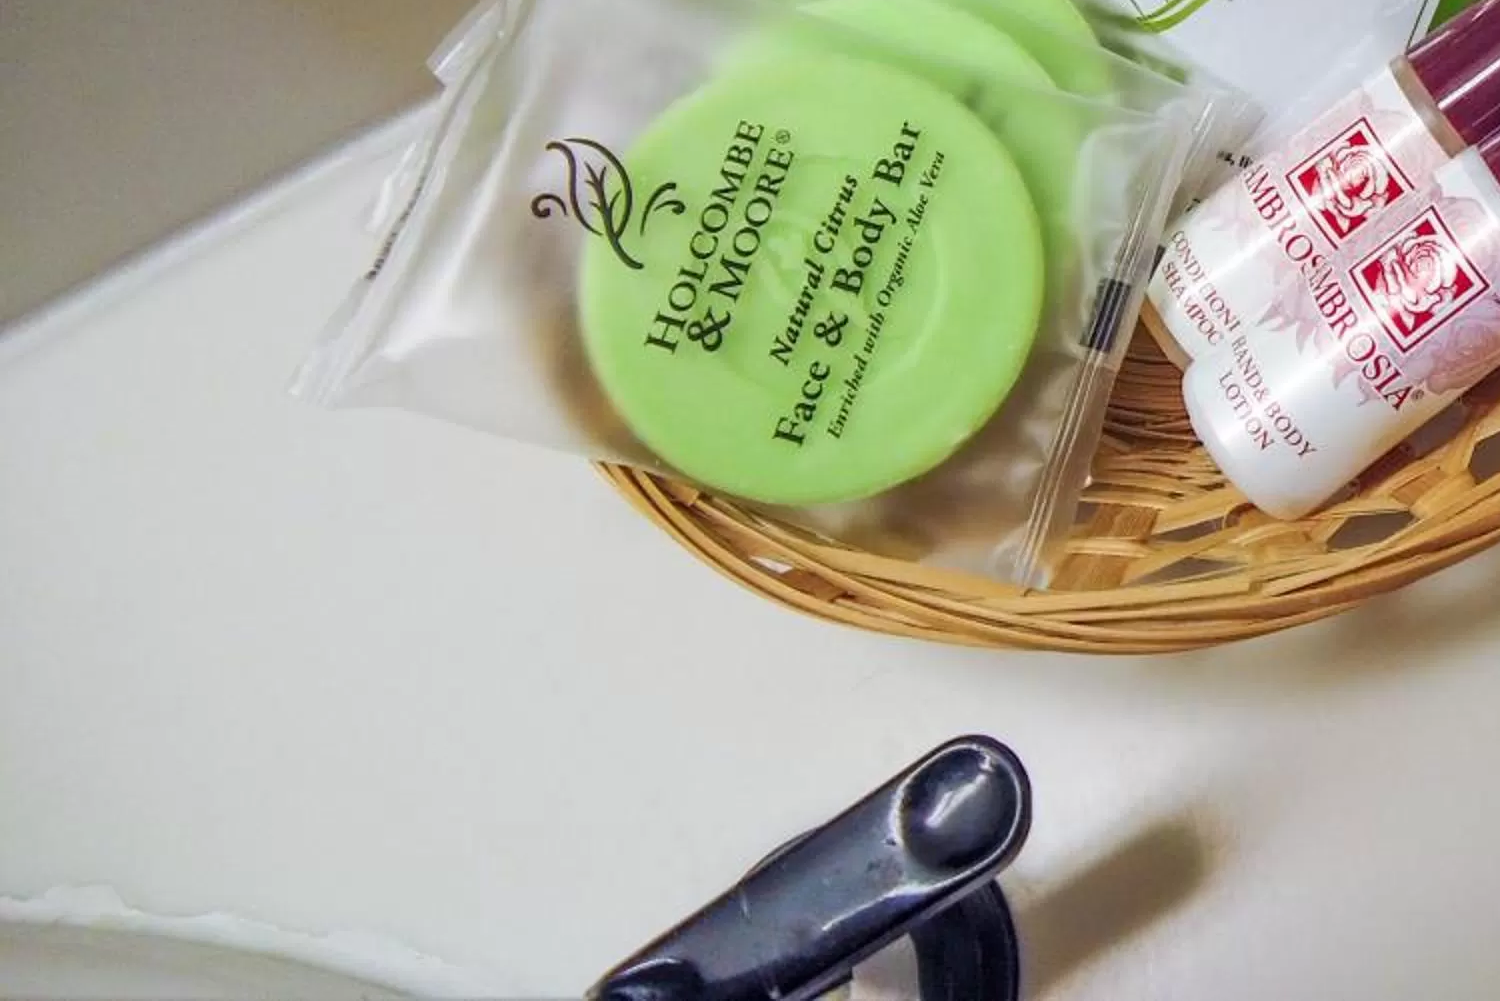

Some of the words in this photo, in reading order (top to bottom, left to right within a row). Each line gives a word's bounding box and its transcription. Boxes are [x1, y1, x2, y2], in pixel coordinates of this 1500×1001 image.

[871, 120, 922, 187] Bar
[644, 120, 765, 355] HOLCOMBE
[768, 258, 824, 367] Natural
[813, 174, 858, 254] Citrus
[830, 195, 897, 296] Body
[686, 305, 731, 352] &
[813, 310, 849, 347] &
[827, 354, 868, 439] Enriched
[863, 312, 886, 354] with
[877, 235, 913, 307] Organic
[906, 193, 929, 235] Aloe
[919, 150, 945, 188] Vera
[772, 360, 831, 448] Face
[1218, 370, 1275, 452] LOTION
